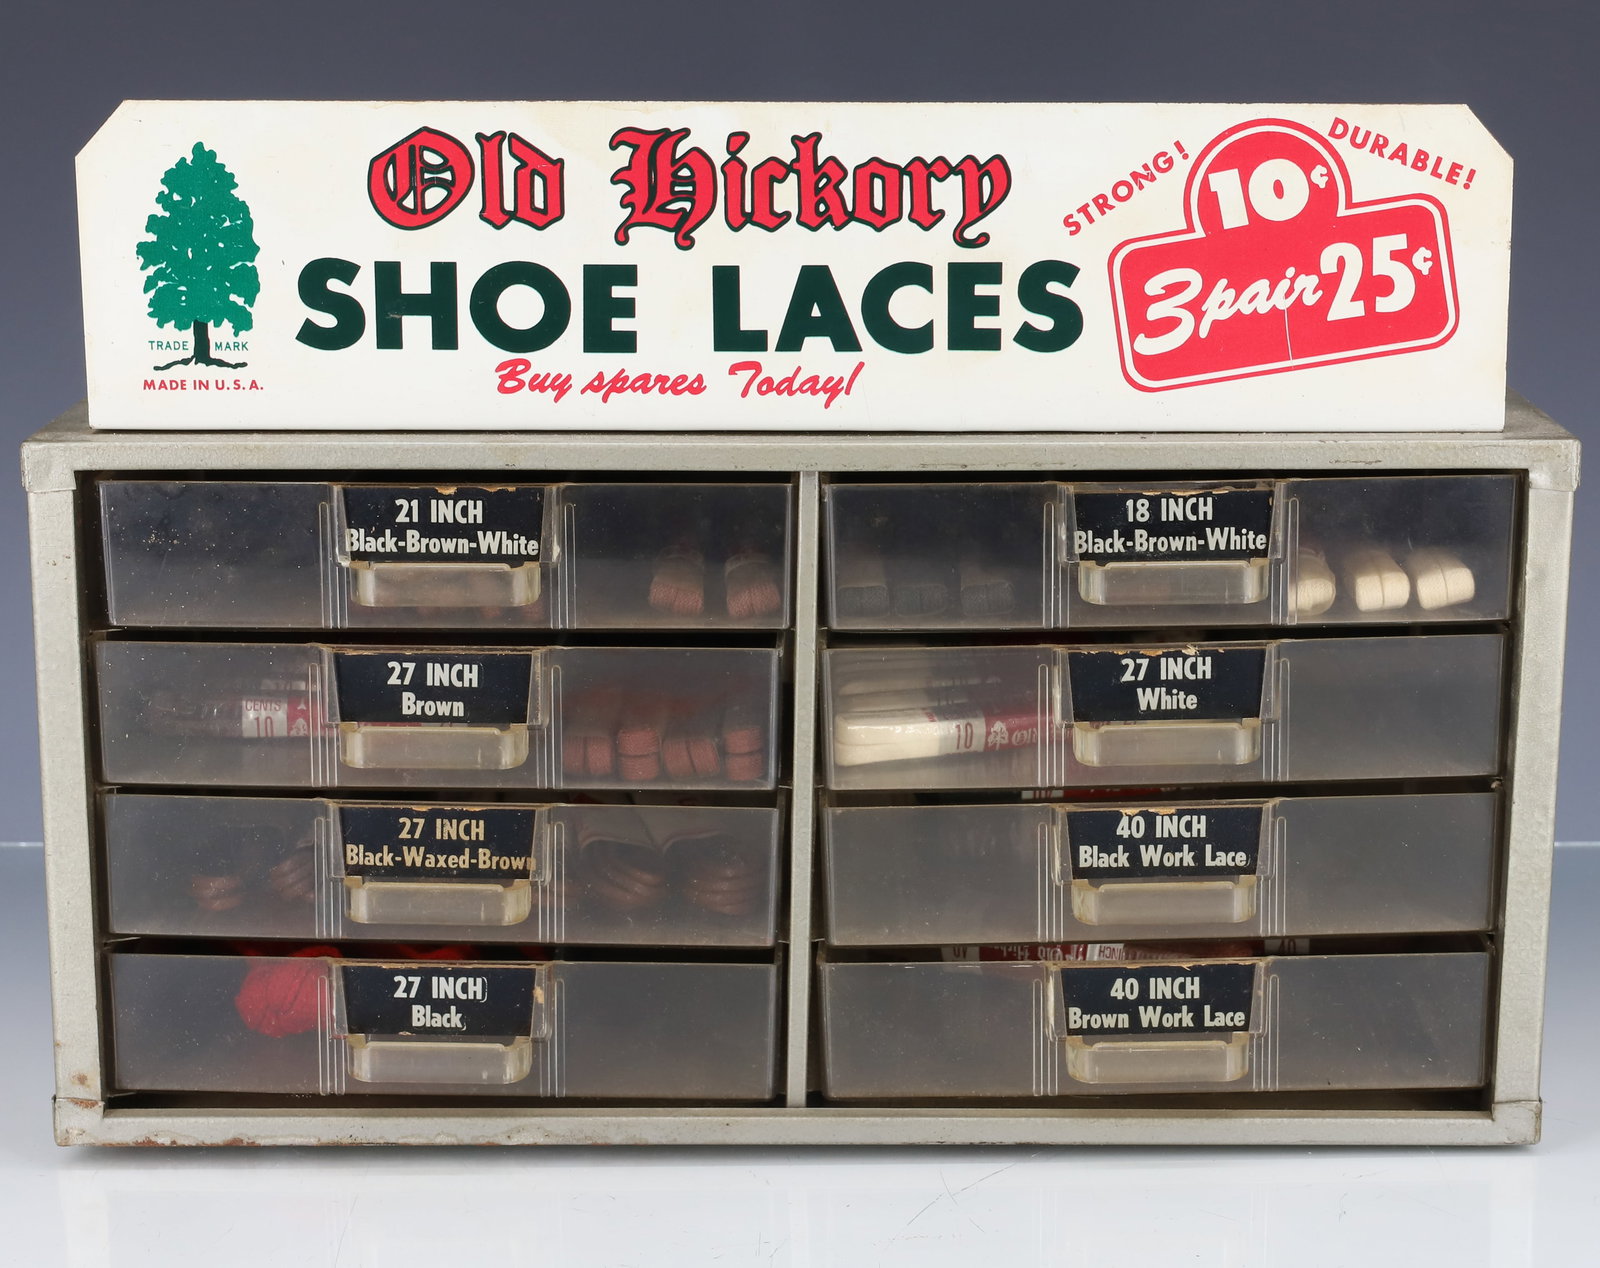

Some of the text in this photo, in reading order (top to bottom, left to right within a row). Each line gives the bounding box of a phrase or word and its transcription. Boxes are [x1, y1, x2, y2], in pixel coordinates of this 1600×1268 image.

[1328, 117, 1477, 190] DURABLE!
[367, 126, 1012, 250] Old Hickory
[1063, 140, 1190, 236] STRONG!
[1207, 158, 1329, 230] 10¢
[296, 258, 1084, 354] SHOE LACES
[1133, 233, 1433, 356] 3 pair 25¢
[148, 340, 249, 352] TRADE MARK
[143, 379, 188, 391] MADE
[193, 379, 210, 391] IN
[495, 358, 573, 403] Buy
[580, 368, 707, 403] spares
[395, 498, 483, 524] 21 INCH
[1126, 497, 1213, 522] 18 INCH
[345, 529, 540, 556] Black-Brown-White
[1074, 527, 1268, 554] Black-Brown-White
[387, 661, 479, 687] 27 INCH
[1120, 656, 1212, 682] 27 INCH
[402, 691, 465, 717] Brown
[1136, 687, 1198, 711] White
[955, 722, 973, 750] 10
[398, 817, 485, 841] 27 INCH
[1116, 815, 1207, 839] 40 INCH
[345, 844, 537, 870] Black-Waxed-Brown
[1079, 843, 1247, 868] Black Work Lace
[393, 975, 483, 1000] 27 INCH
[1110, 976, 1200, 1000] 40 INCH
[411, 1004, 463, 1028] Black
[1068, 1004, 1246, 1029] Brown Work Lace
